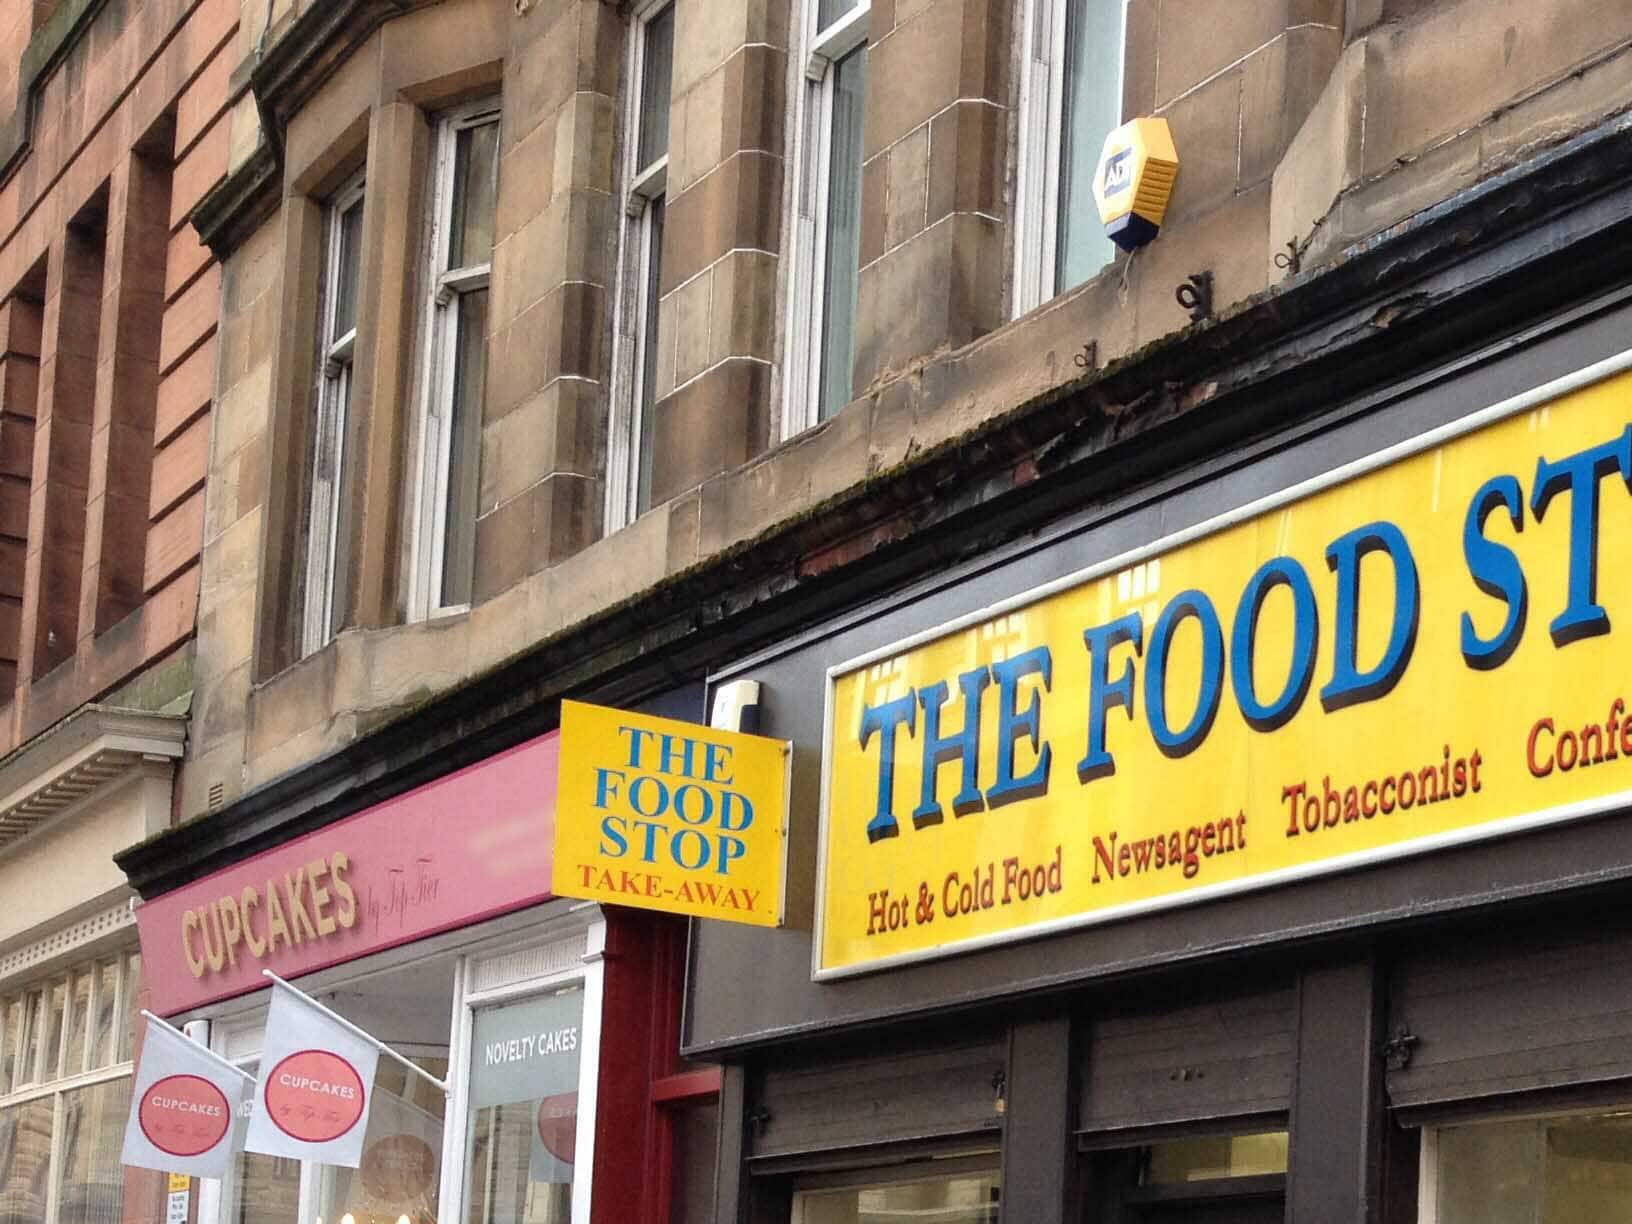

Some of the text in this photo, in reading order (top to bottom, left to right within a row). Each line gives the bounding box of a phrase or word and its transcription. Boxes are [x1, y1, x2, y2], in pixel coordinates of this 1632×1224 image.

[858, 645, 1052, 844] THE
[1077, 520, 1420, 785] FOOD
[618, 725, 734, 785] THE
[593, 767, 755, 832] FOOD
[600, 815, 746, 876] STOP
[867, 888, 909, 936] Hot
[916, 890, 936, 924] &
[942, 863, 996, 917] Cold
[1002, 846, 1063, 906] Food
[1092, 810, 1247, 884] Newsagent
[1282, 748, 1483, 838] Tobacconist
[181, 851, 360, 980] CUPCAKES
[577, 864, 760, 913] TAKE-AWAY
[486, 1028, 577, 1066] NOVELTY CAKES
[152, 1095, 222, 1117] CUPCAKES
[280, 1073, 355, 1100] CUPCAKES
